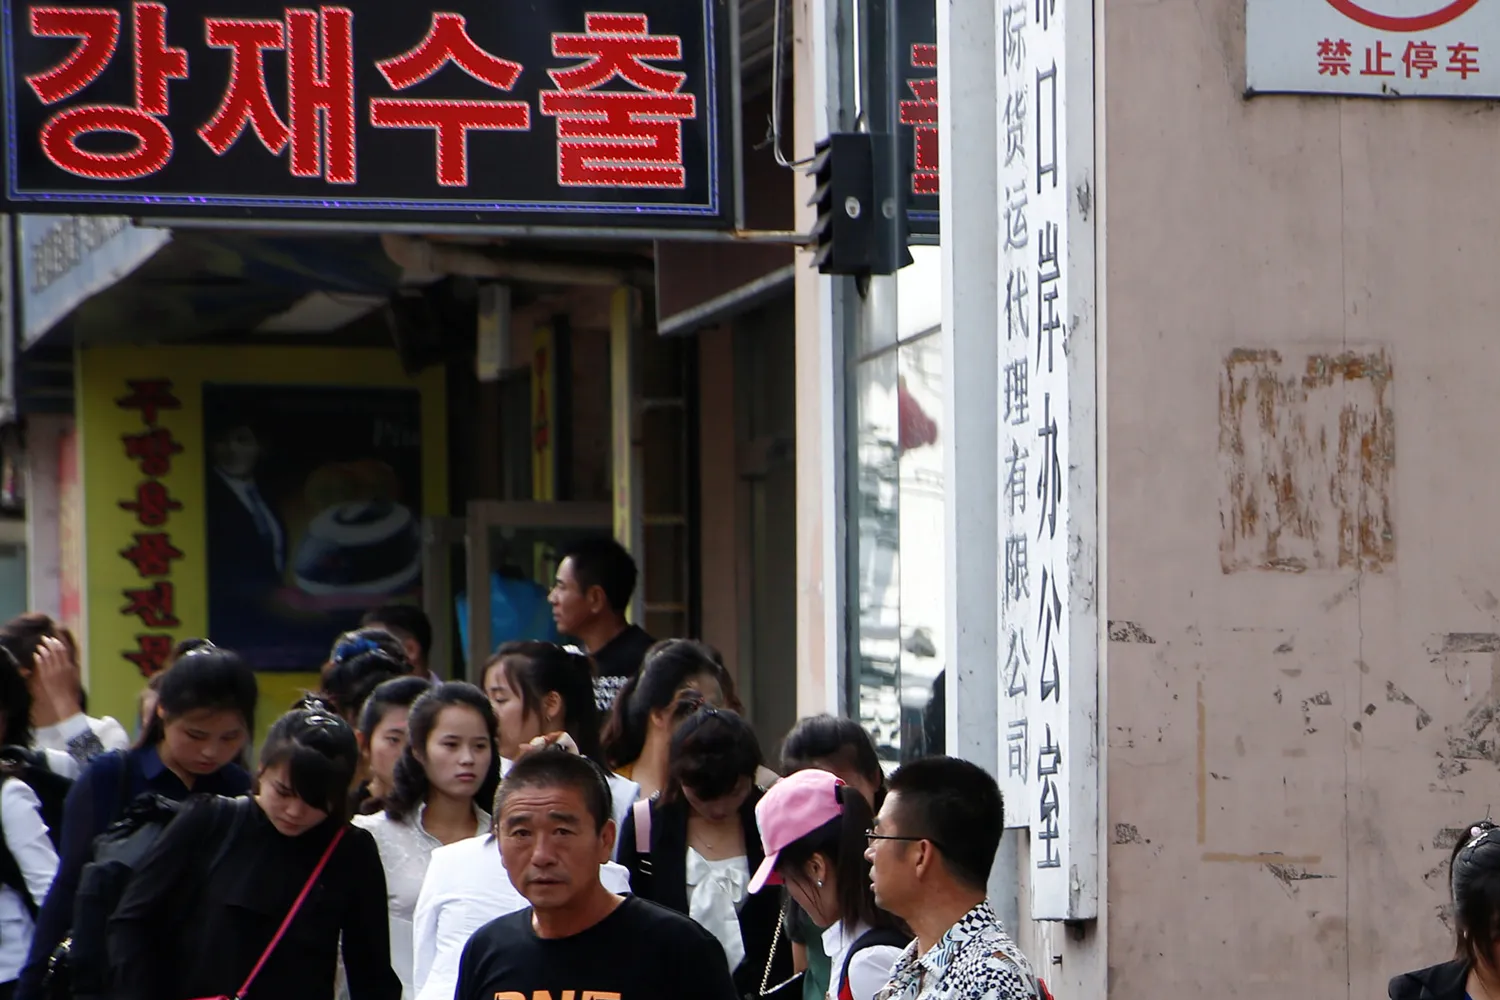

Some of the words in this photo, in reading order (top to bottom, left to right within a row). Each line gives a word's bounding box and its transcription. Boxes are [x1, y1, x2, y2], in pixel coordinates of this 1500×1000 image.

[25, 3, 696, 188] 강재수출
[1317, 38, 1480, 79] 禁止停车
